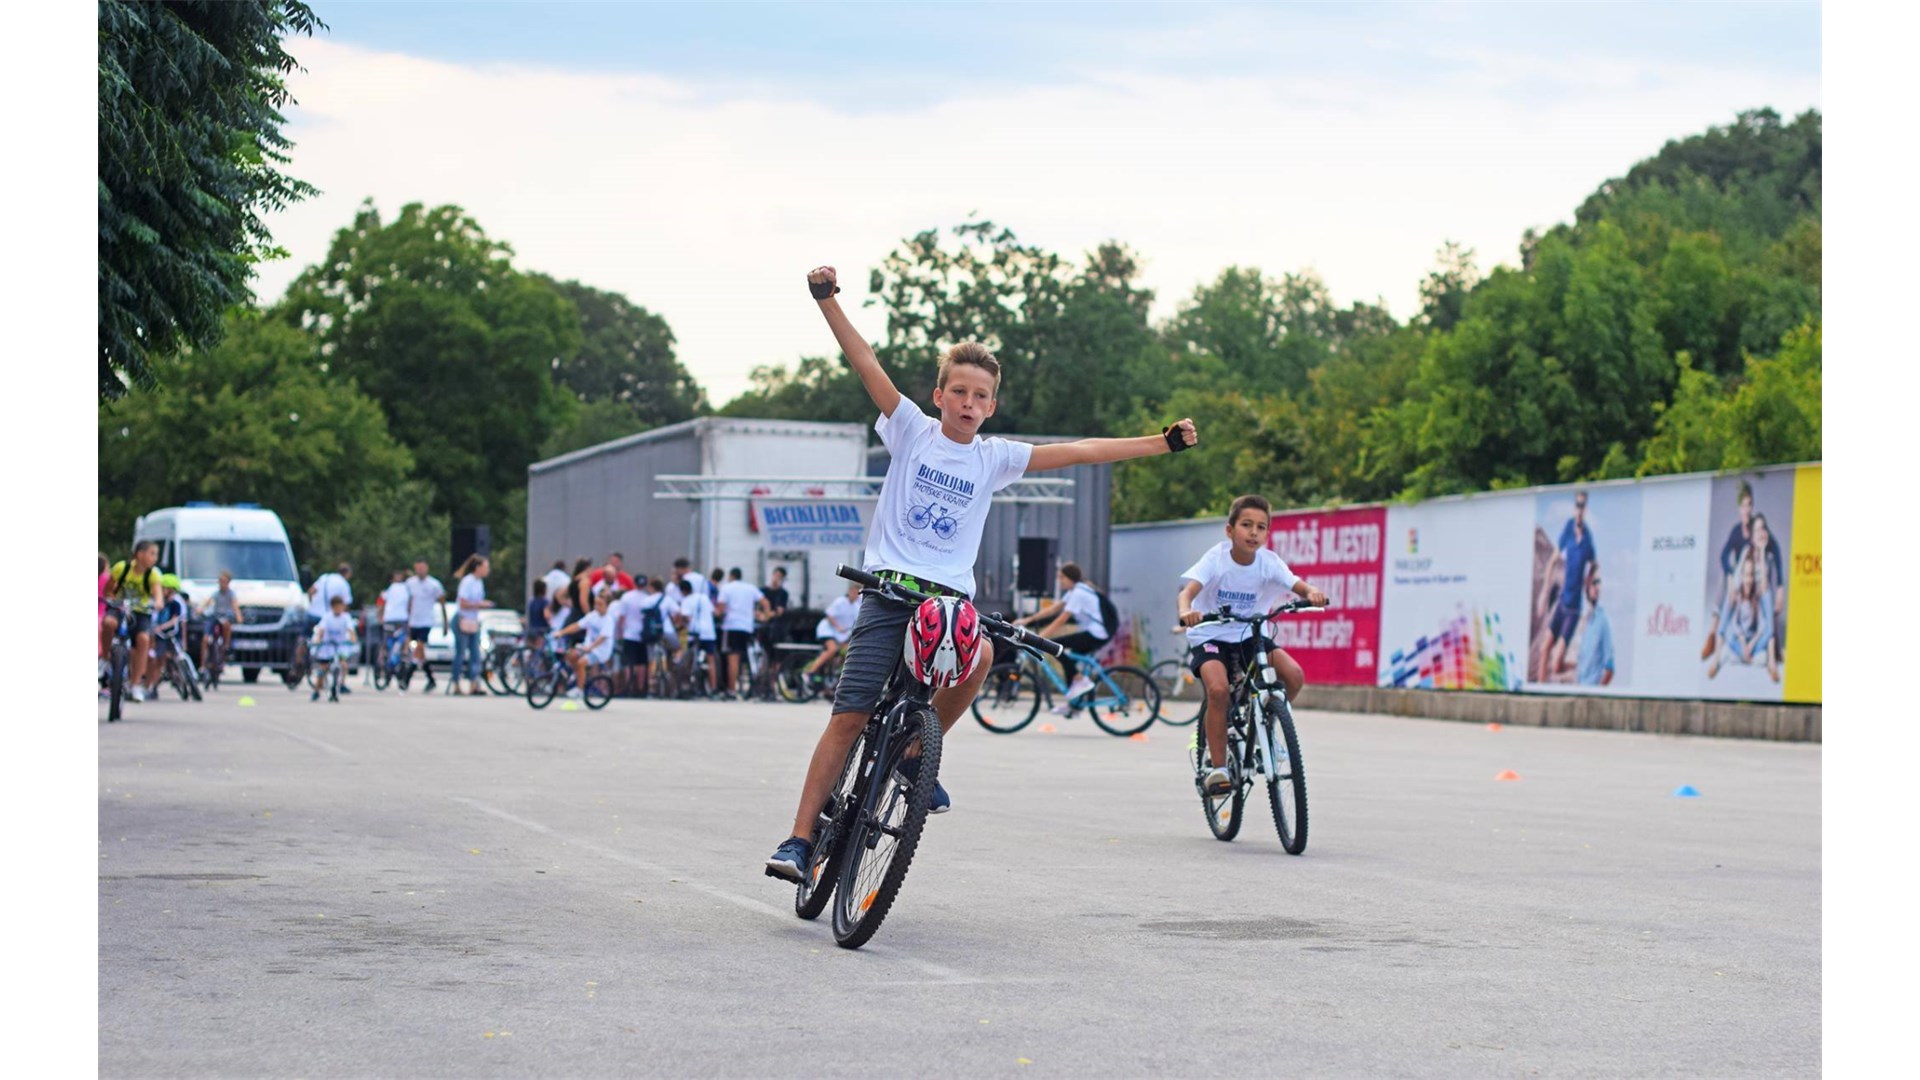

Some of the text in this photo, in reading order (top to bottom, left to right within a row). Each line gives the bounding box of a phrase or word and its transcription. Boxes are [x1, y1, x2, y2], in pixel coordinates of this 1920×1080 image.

[913, 481, 943, 499] IMOTSKE
[917, 464, 975, 496] BICIKLIJADA
[763, 504, 861, 528] BICIKLIJADA
[1321, 523, 1380, 564] MJESTO
[1346, 572, 1378, 609] DAN
